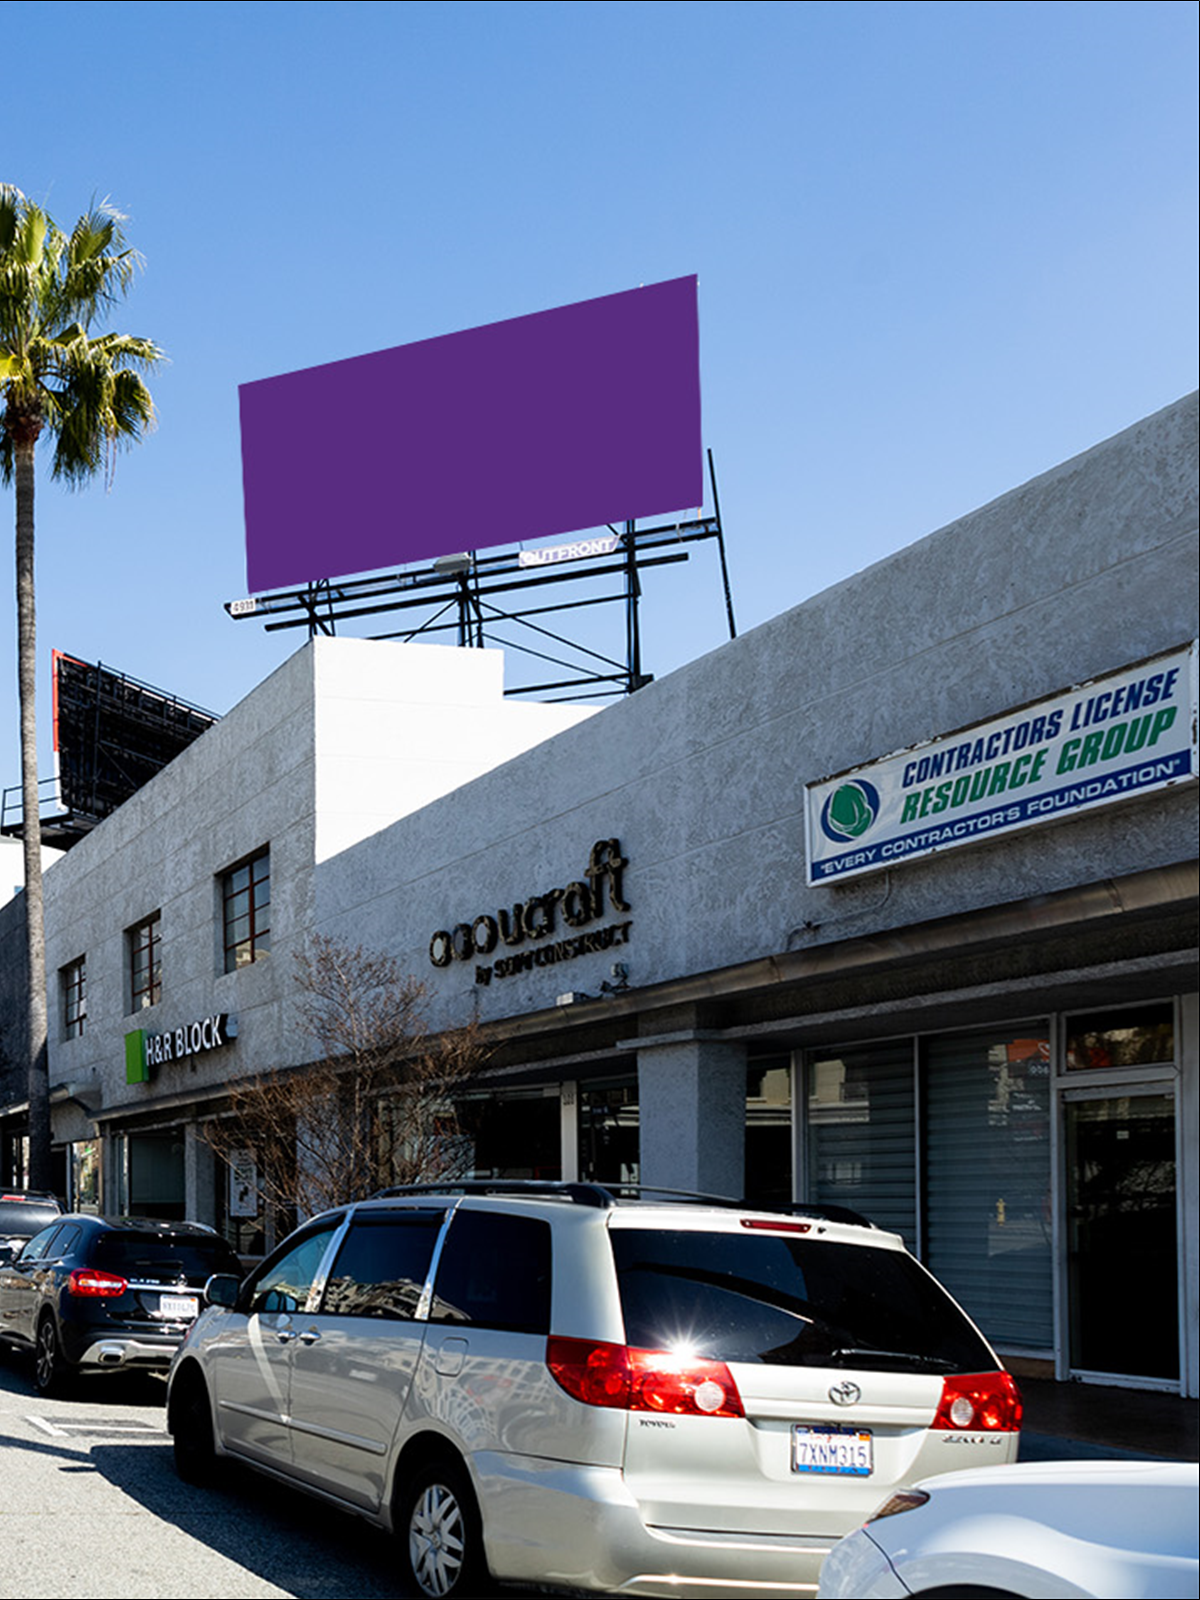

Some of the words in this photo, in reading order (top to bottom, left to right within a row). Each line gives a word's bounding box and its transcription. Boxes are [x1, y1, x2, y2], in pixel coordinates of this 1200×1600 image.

[521, 539, 615, 565] OUTFRONT
[902, 709, 1064, 788] CONTRACTORS
[1070, 667, 1180, 732] LICENSE
[900, 747, 1050, 824] RESOURCE
[1056, 706, 1178, 775] GROUP
[145, 1032, 173, 1066] H&R
[175, 1014, 222, 1059] BLOCK
[799, 1442, 867, 1467] 7XNM315
